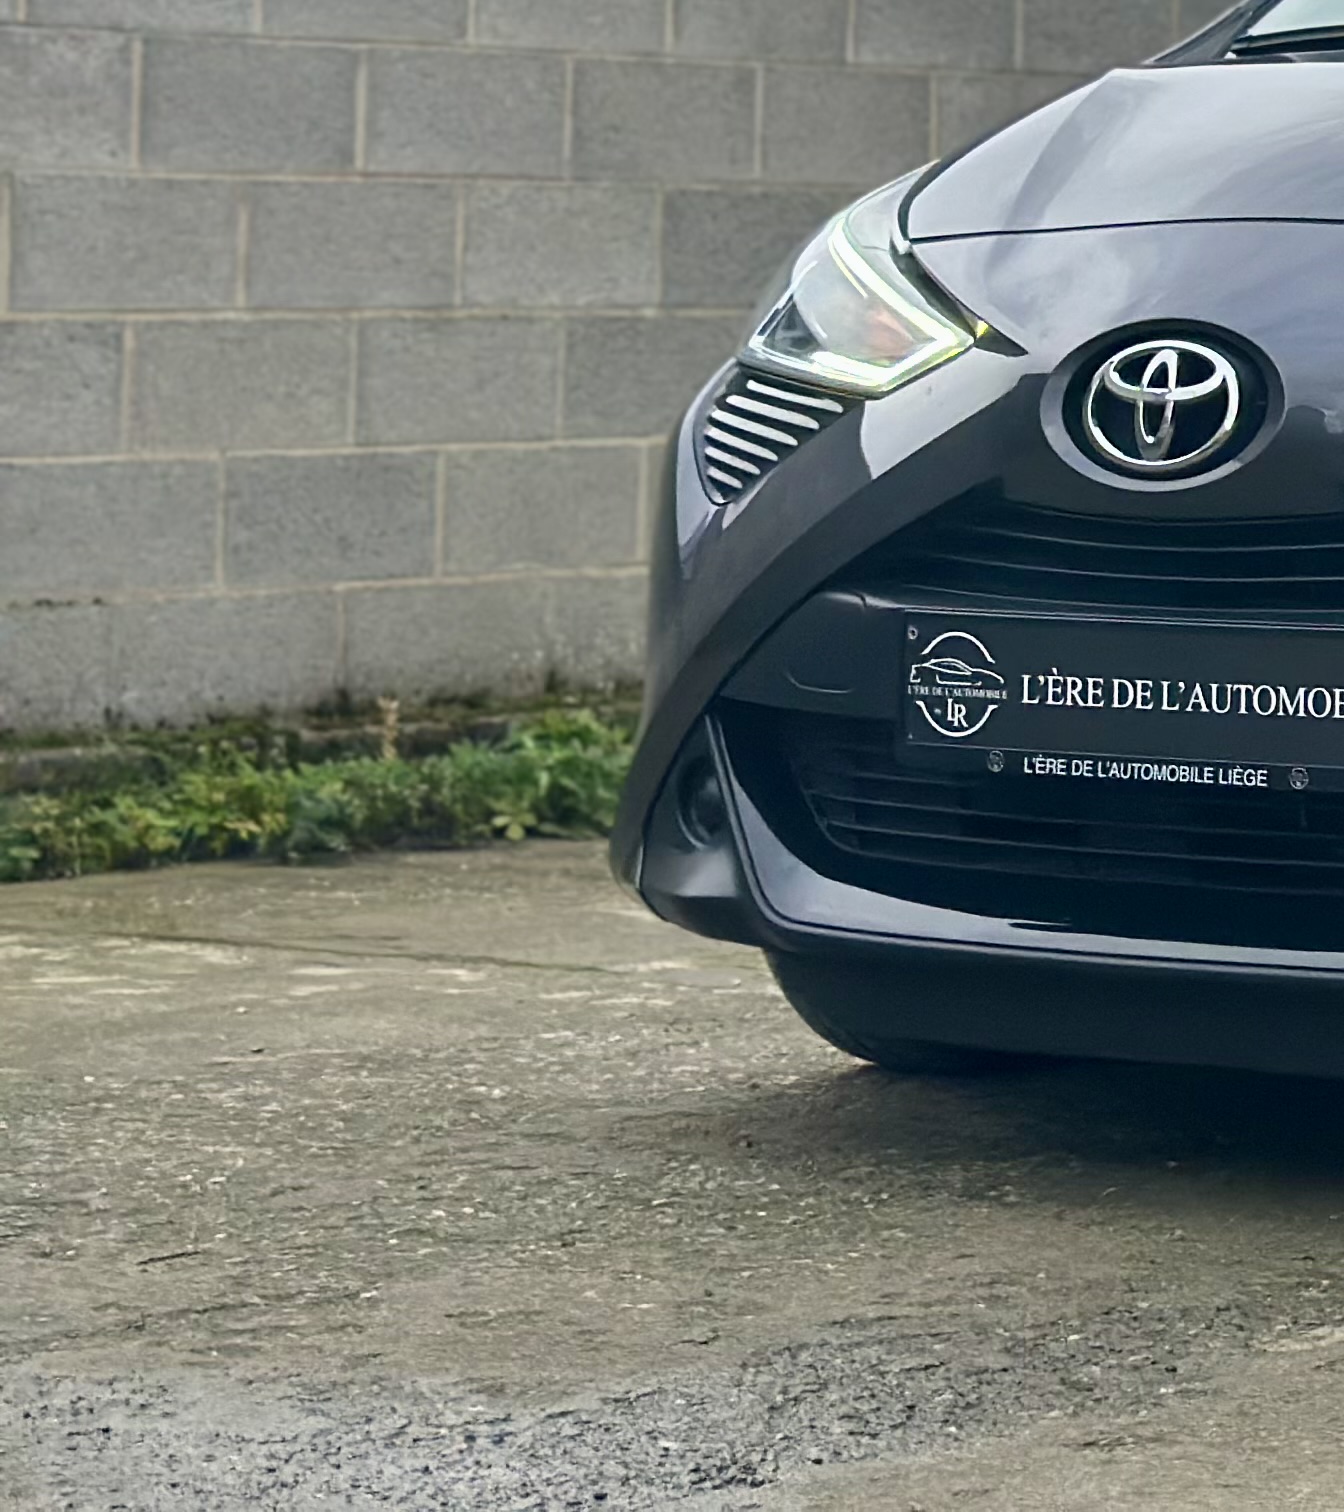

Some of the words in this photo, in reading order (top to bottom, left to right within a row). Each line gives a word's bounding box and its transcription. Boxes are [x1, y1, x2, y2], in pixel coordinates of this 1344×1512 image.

[1020, 667, 1105, 708] L'ÈRE
[1111, 678, 1155, 710] DE
[946, 697, 969, 728] LR
[1023, 754, 1068, 776] L'ÈRE
[1070, 759, 1094, 778] DE
[1097, 760, 1215, 785] L'AUTOMOBILE
[1218, 764, 1269, 788] LIÈGE
